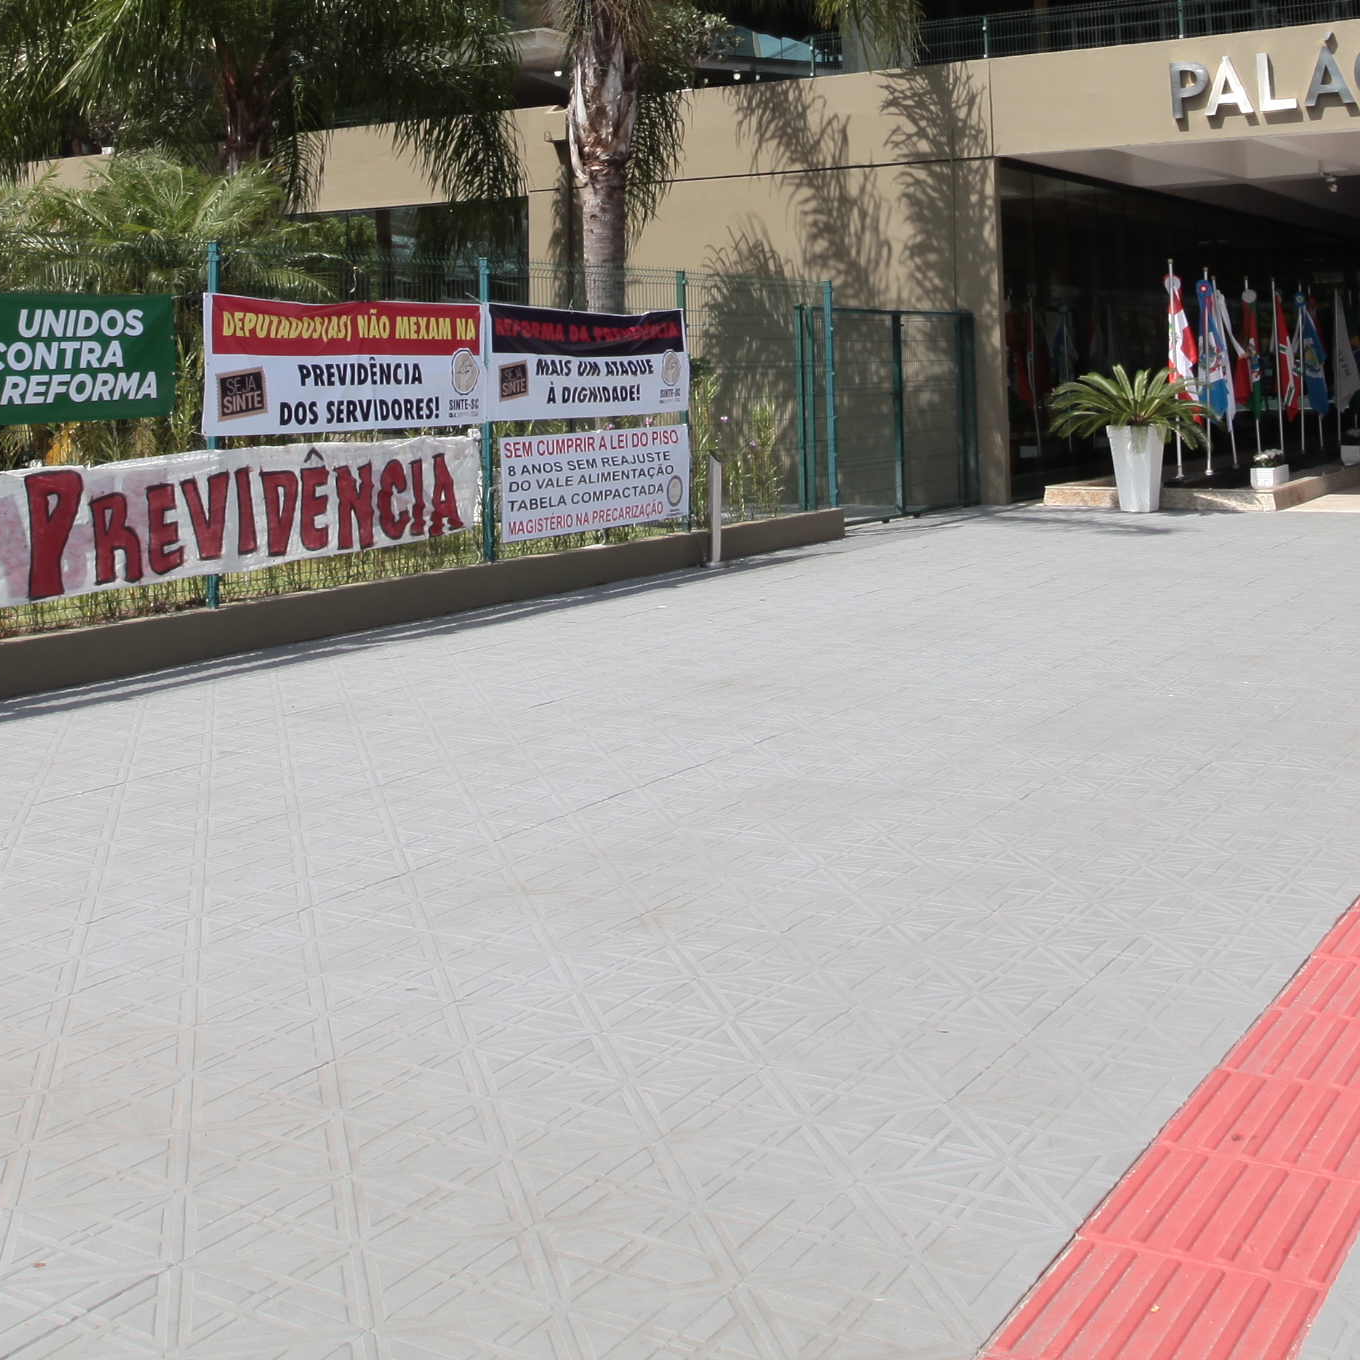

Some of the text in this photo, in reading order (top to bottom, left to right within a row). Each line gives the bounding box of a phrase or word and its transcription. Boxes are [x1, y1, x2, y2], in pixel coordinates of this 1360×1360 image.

[18, 308, 143, 338] UNIDOS
[357, 309, 390, 339] NÃO
[395, 316, 452, 340] MEXAM
[456, 318, 476, 340] NA
[495, 318, 566, 341] REFORMA
[569, 324, 591, 342] DA
[298, 357, 423, 387] PREVIDÊNCIA
[504, 369, 523, 382] SEJA
[536, 358, 654, 378] MAIS UM ATAQUE
[0, 372, 158, 405] REFORMA
[226, 376, 257, 396] SEJA
[502, 379, 527, 395] SINTE
[546, 382, 640, 404] À DIGNIDADE!
[223, 390, 262, 414] SINTE
[279, 396, 440, 426] DOS SERVIDORES!
[449, 398, 479, 410] SINTE-SC
[504, 429, 678, 458] SEM CUMPRIR A LEI DO PISO
[508, 450, 671, 476] 8 ANOS SEM REAJUSTE
[509, 463, 674, 492] DO VALE ALIMENTAÇÃO
[508, 483, 664, 512] TABELA COMPACTADA
[24, 447, 464, 601] PREVIDÊNCIA
[508, 499, 664, 536] MAGISTÉRIO NA PRECARIZAÇÃO
